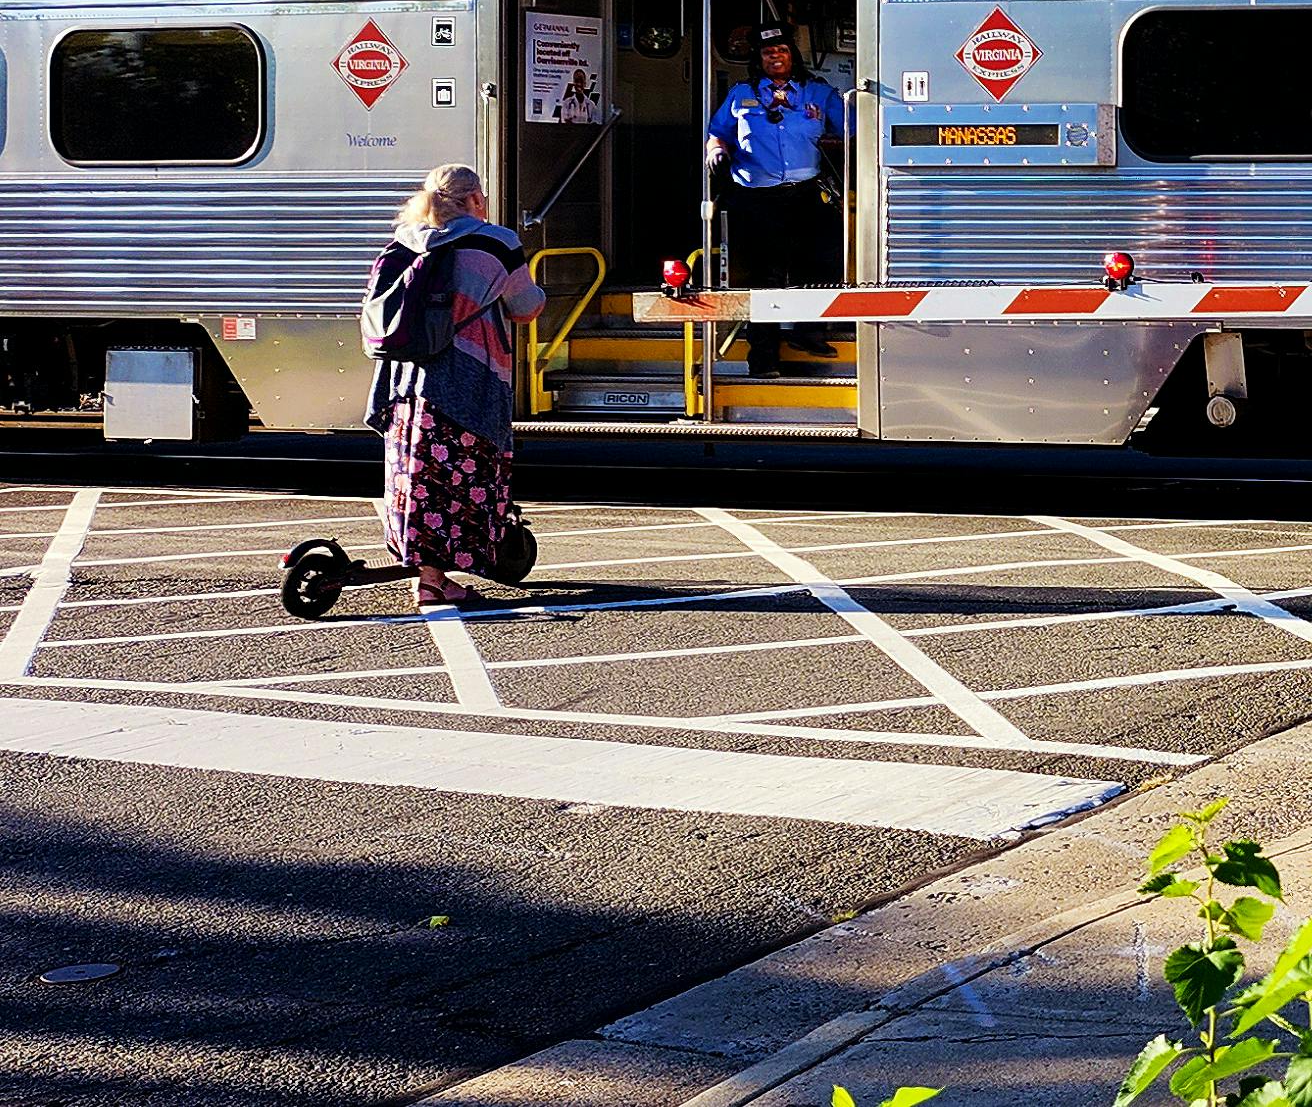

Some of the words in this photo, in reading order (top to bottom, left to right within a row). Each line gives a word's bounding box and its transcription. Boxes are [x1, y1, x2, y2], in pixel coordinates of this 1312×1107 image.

[971, 30, 1025, 46] RAILWAY
[347, 42, 394, 56] RAILWAY
[973, 48, 1022, 62] VIRGINIA
[348, 59, 391, 71] VIRGINIA
[971, 64, 1025, 78] EXPRESS
[346, 73, 393, 87] EXPRESS
[346, 132, 397, 148] Welcome
[938, 126, 1017, 145] MANASSAS
[606, 394, 647, 404] RICON
